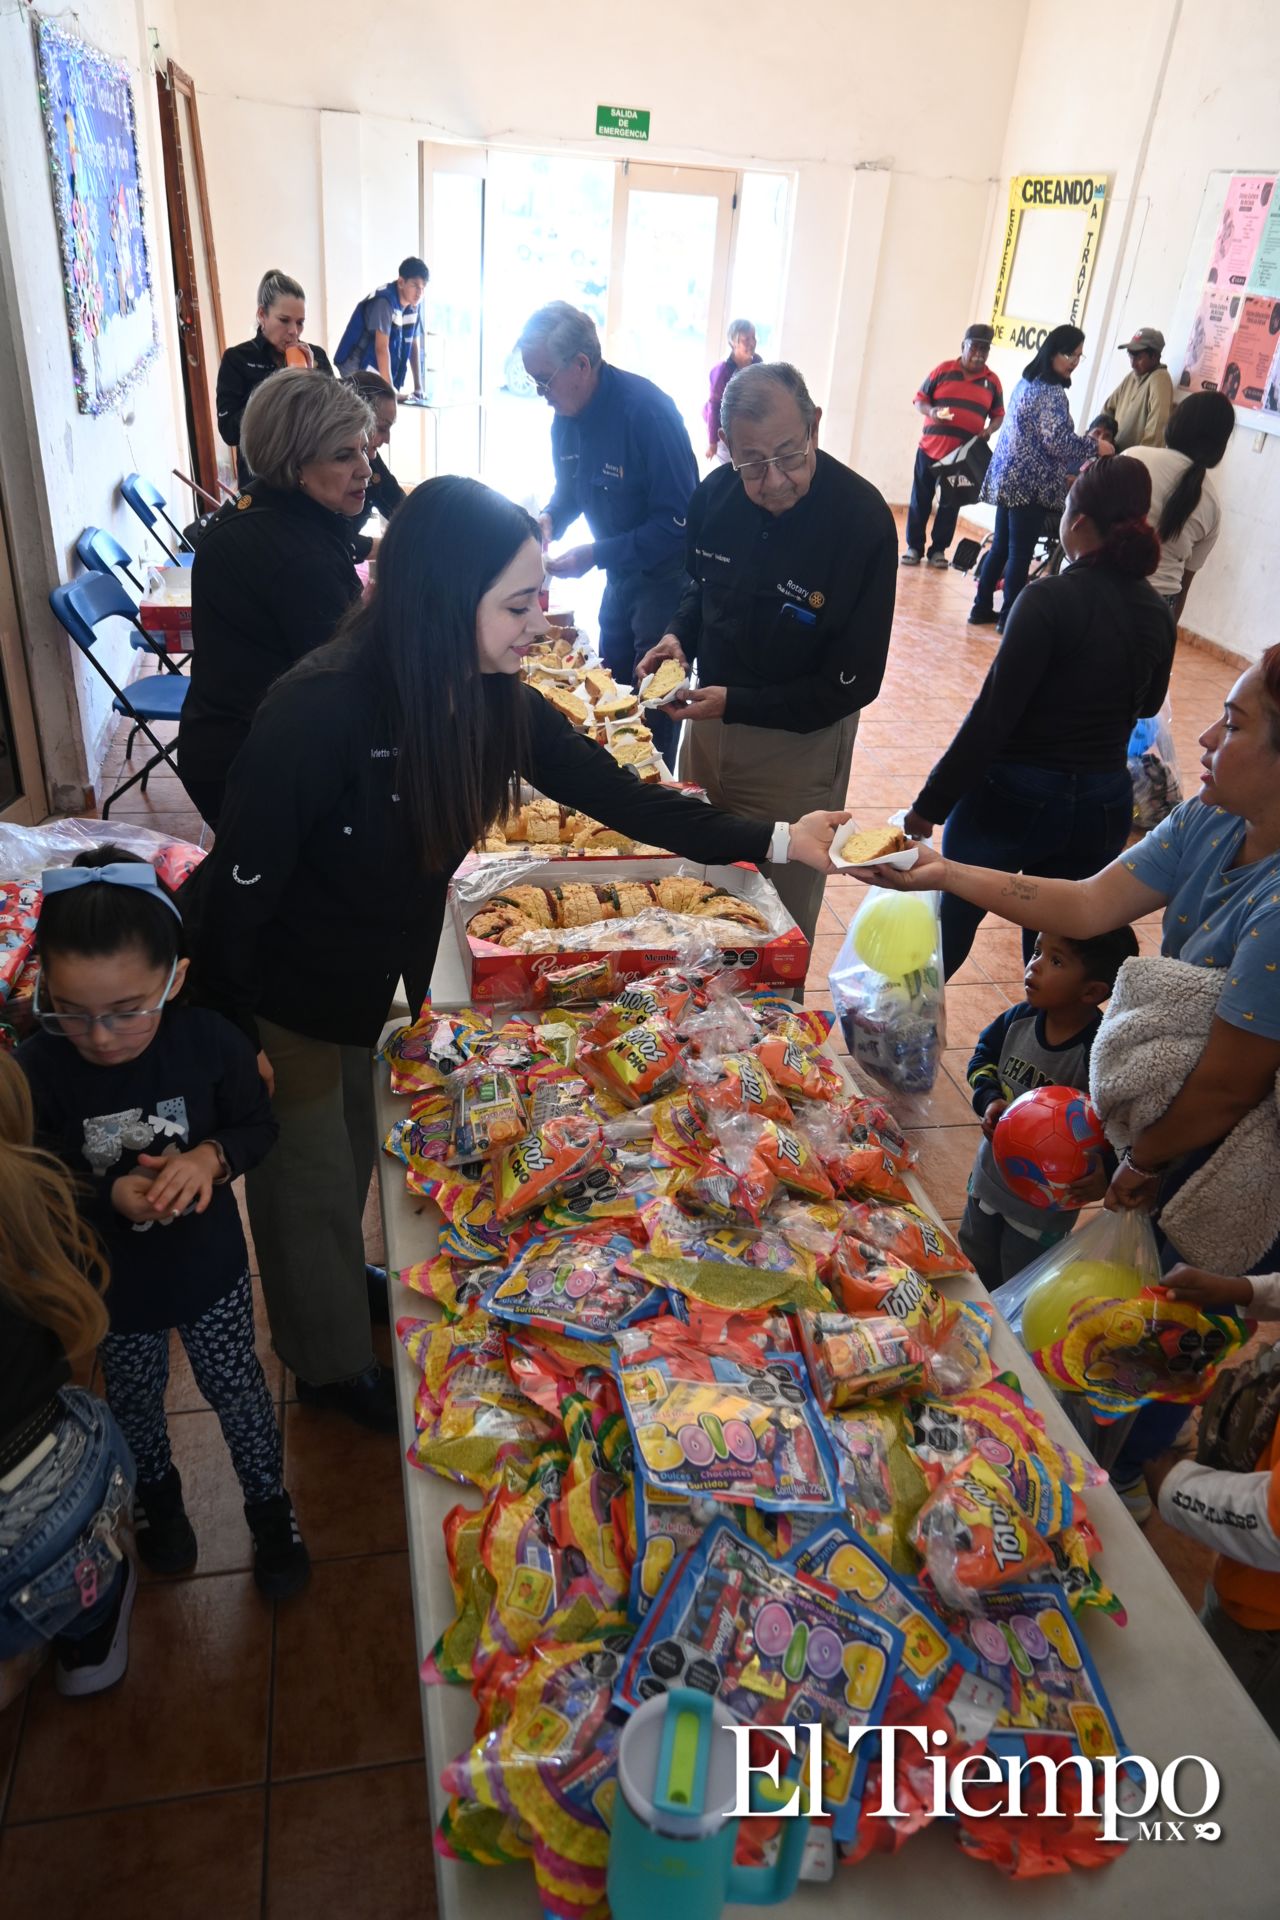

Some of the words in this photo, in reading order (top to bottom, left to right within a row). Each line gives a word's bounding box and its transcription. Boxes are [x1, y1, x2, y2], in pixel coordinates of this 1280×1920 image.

[610, 108, 638, 119] SALIDA
[618, 119, 629, 127] DE
[598, 126, 648, 139] EMERGENCIA
[1021, 179, 1095, 205] CREANDO
[1091, 203, 1098, 219] A
[991, 208, 1016, 329] ESPERANZ
[1070, 232, 1094, 327] TRAVES
[786, 579, 809, 598] Rotary
[644, 953, 680, 962] Membe
[514, 1305, 549, 1315] Surtidos
[659, 1470, 692, 1481] Dulces
[701, 1469, 752, 1481] Chocolates
[688, 1479, 730, 1490] Surtidos
